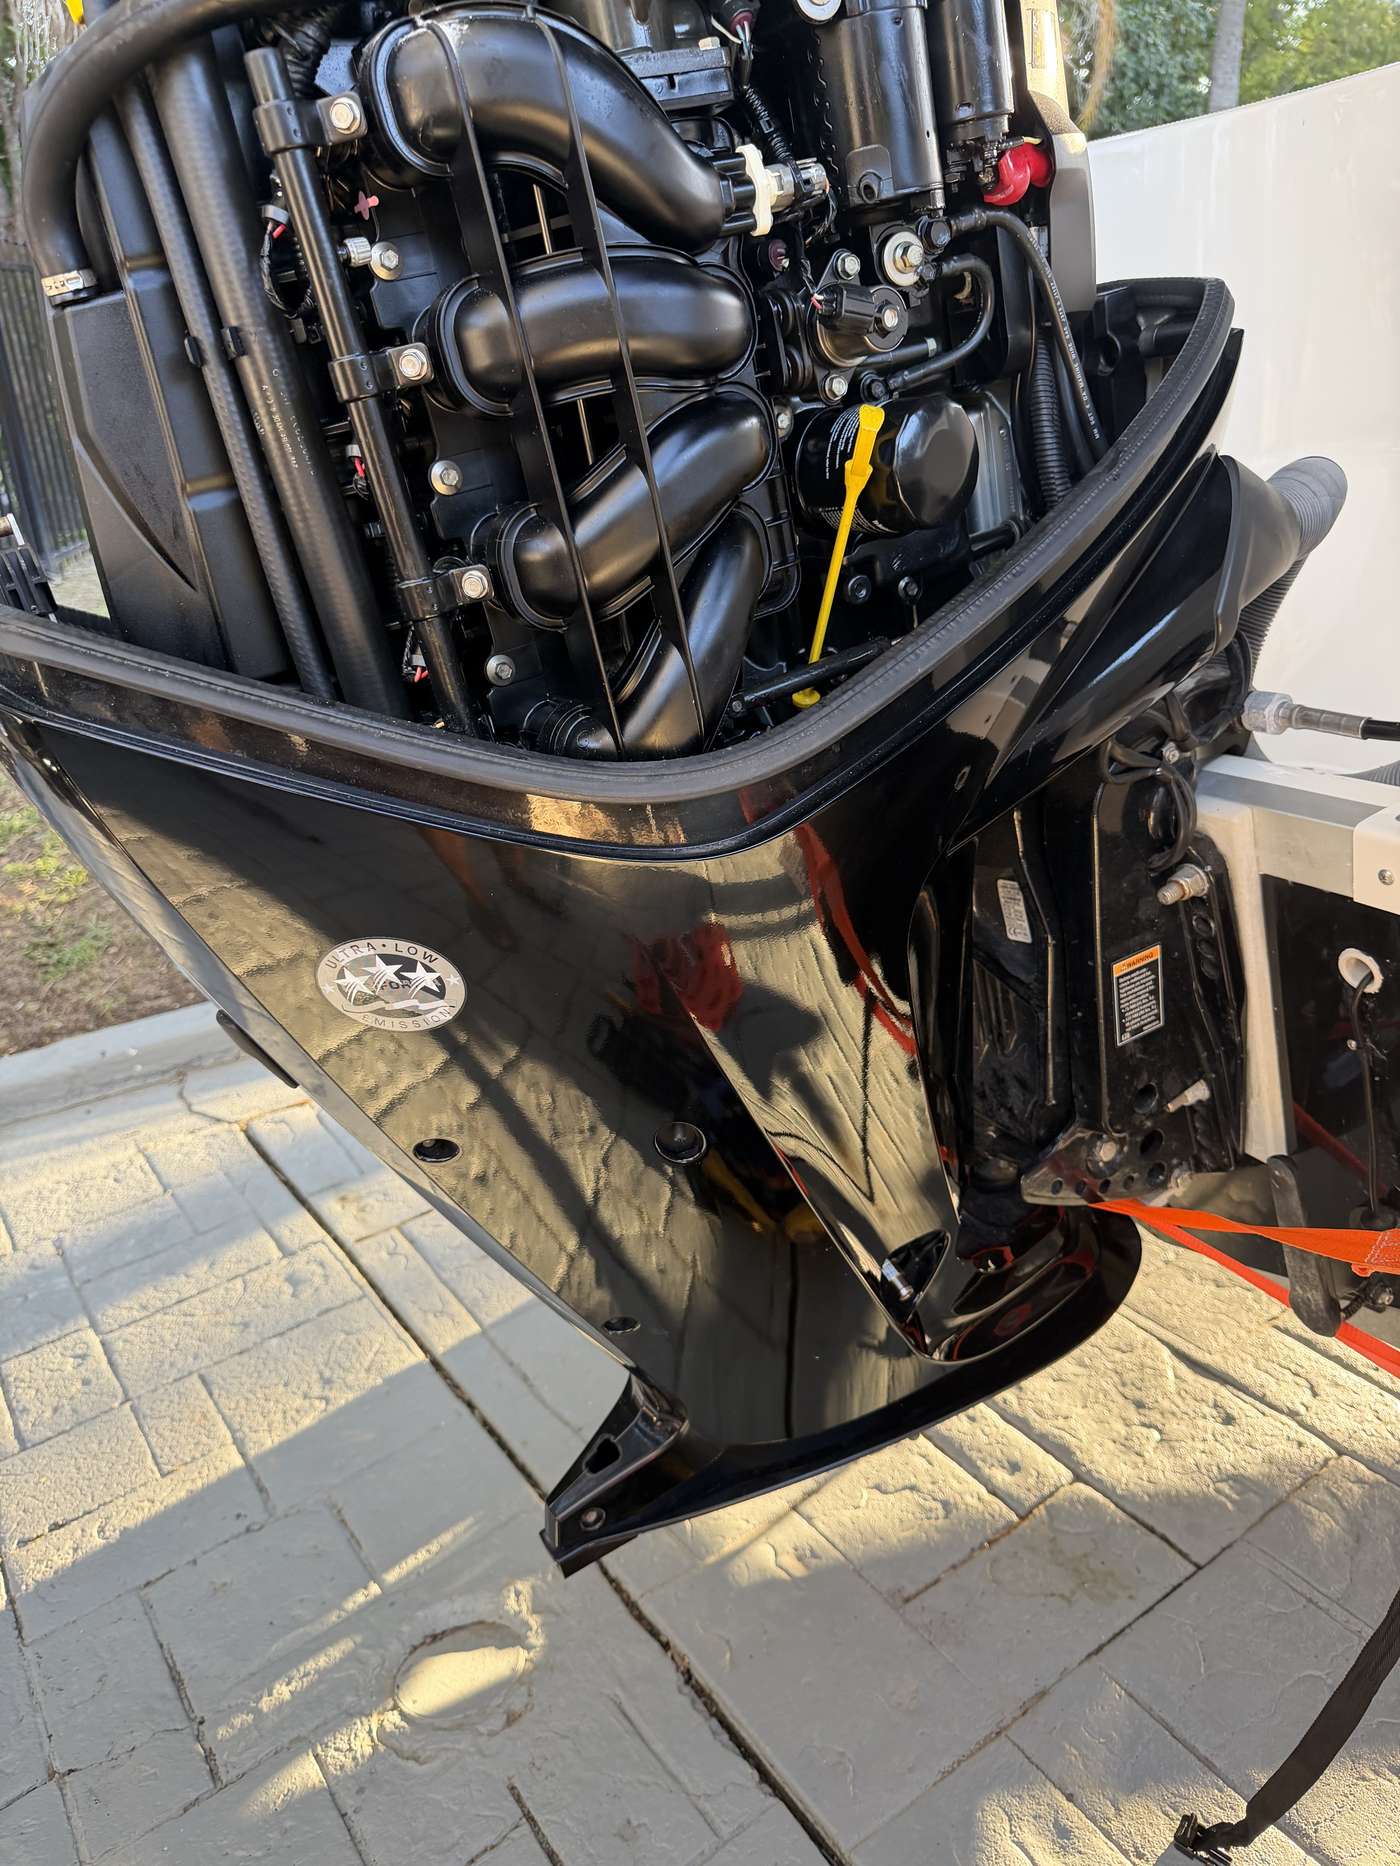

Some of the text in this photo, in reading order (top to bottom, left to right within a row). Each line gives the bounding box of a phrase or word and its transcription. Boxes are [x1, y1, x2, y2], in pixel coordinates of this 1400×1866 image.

[325, 942, 439, 969] ULTRA LOW
[361, 1008, 451, 1029] EMISSION
